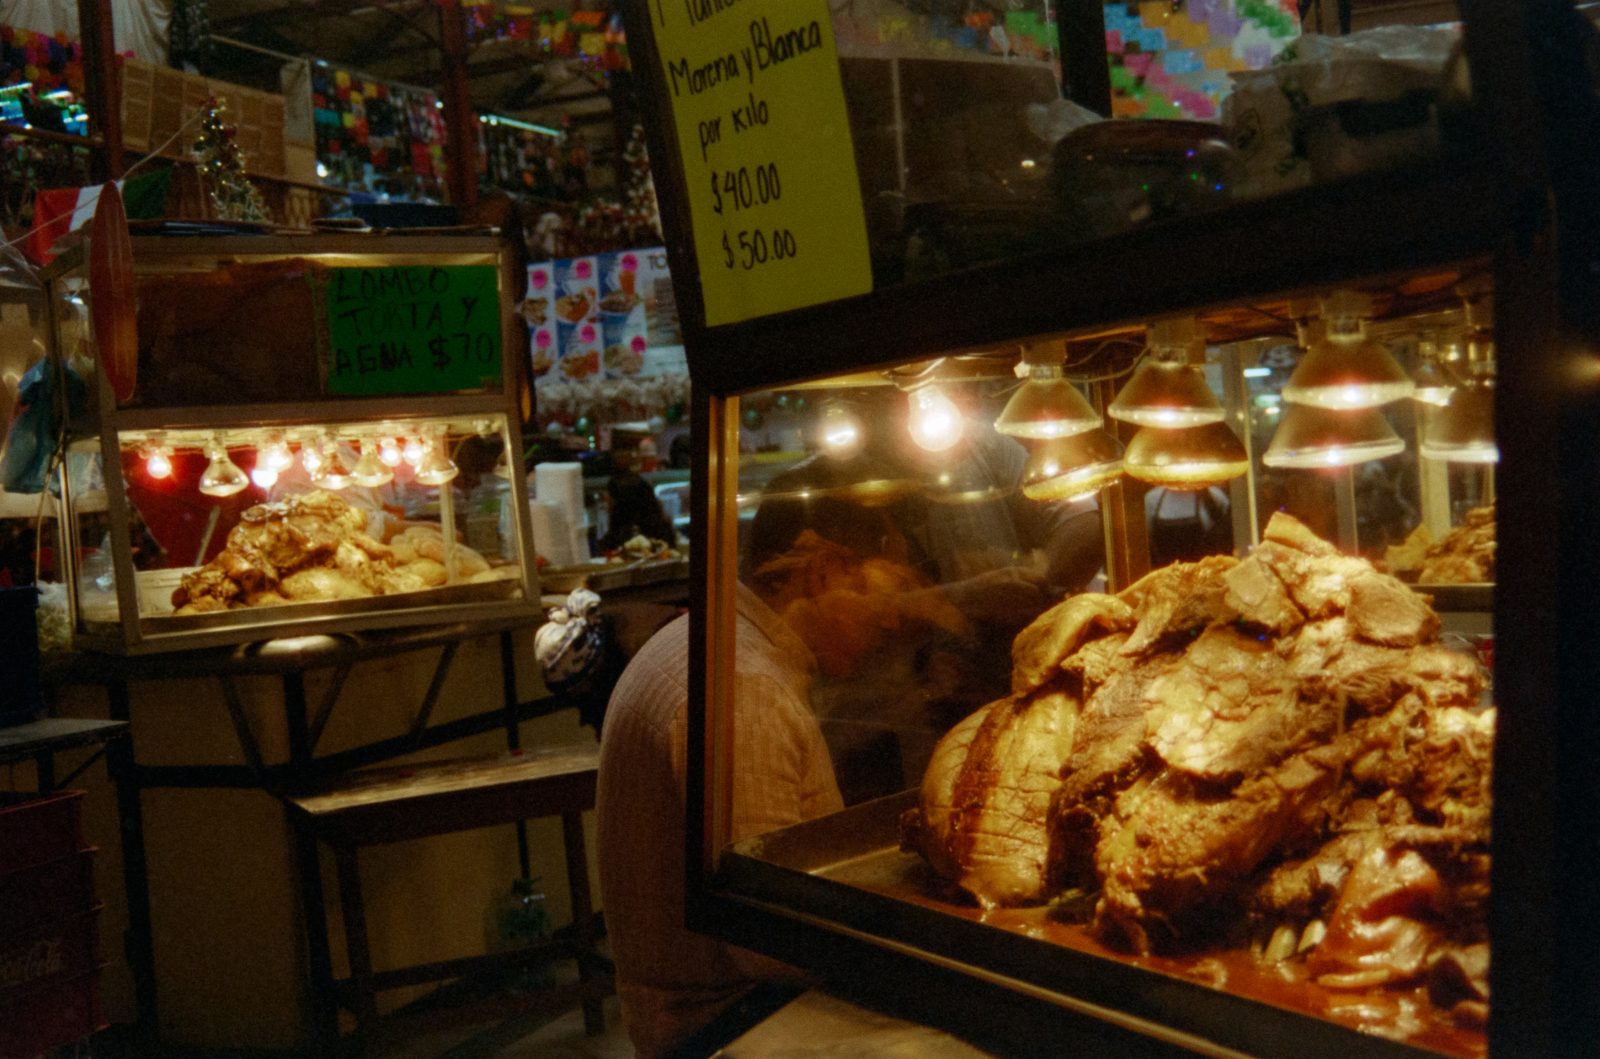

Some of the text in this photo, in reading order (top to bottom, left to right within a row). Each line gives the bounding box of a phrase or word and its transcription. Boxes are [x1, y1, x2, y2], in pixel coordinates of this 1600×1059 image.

[740, 47, 753, 84] y
[750, 16, 822, 71] Blanca
[698, 117, 721, 163] por
[711, 162, 781, 215] $40.00
[722, 229, 796, 271] $50.00
[427, 332, 494, 373] $70
